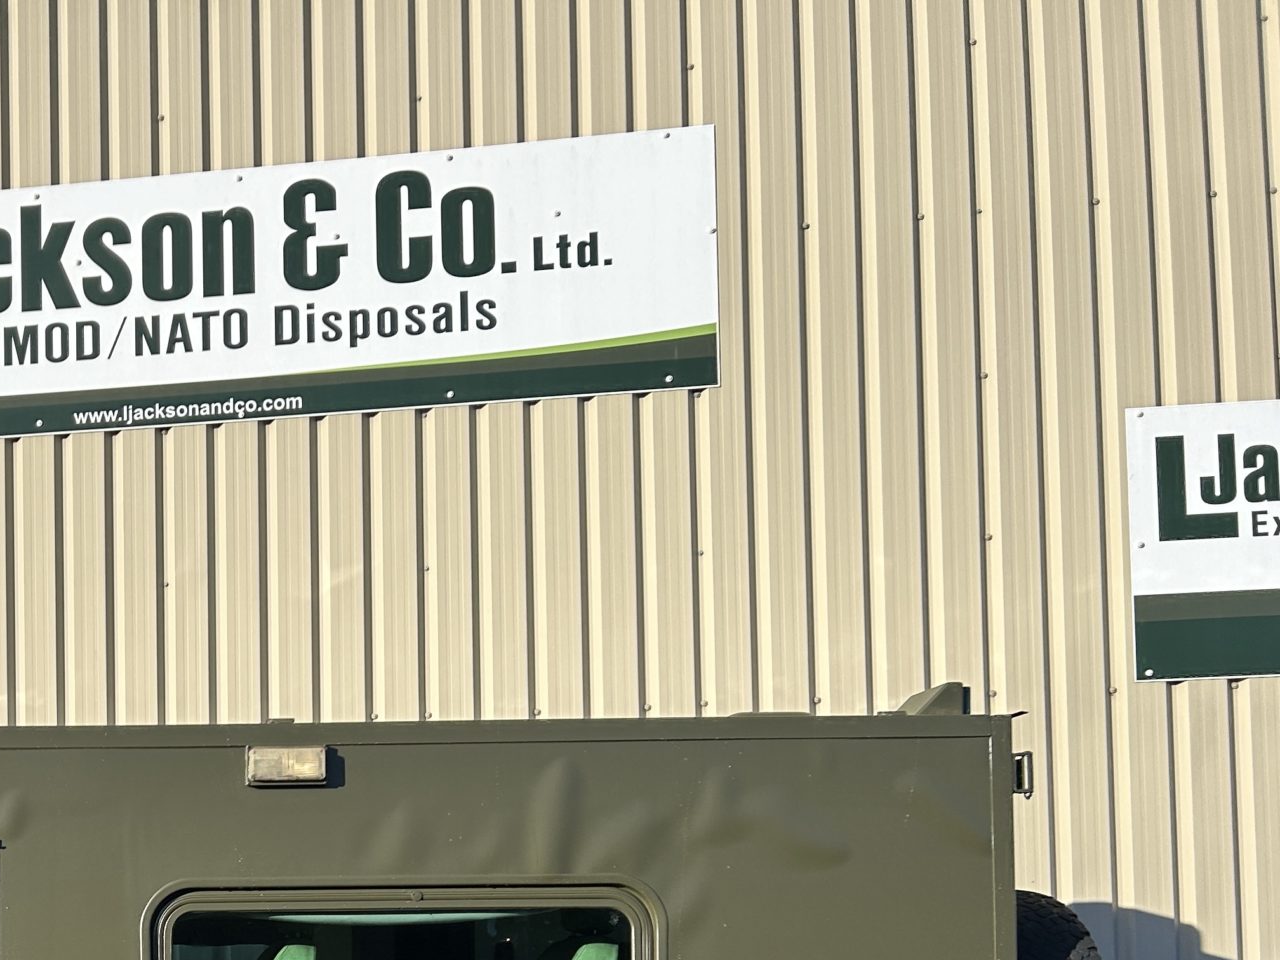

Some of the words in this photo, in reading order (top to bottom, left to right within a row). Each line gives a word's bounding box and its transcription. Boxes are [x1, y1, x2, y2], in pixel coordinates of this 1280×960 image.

[282, 178, 349, 292] &
[375, 170, 517, 284] Co.
[532, 231, 613, 272] Ltd.
[3, 308, 249, 367] MOD/NATO
[274, 290, 497, 348] Disposals
[73, 396, 303, 425] www.ljacksonandco.com
